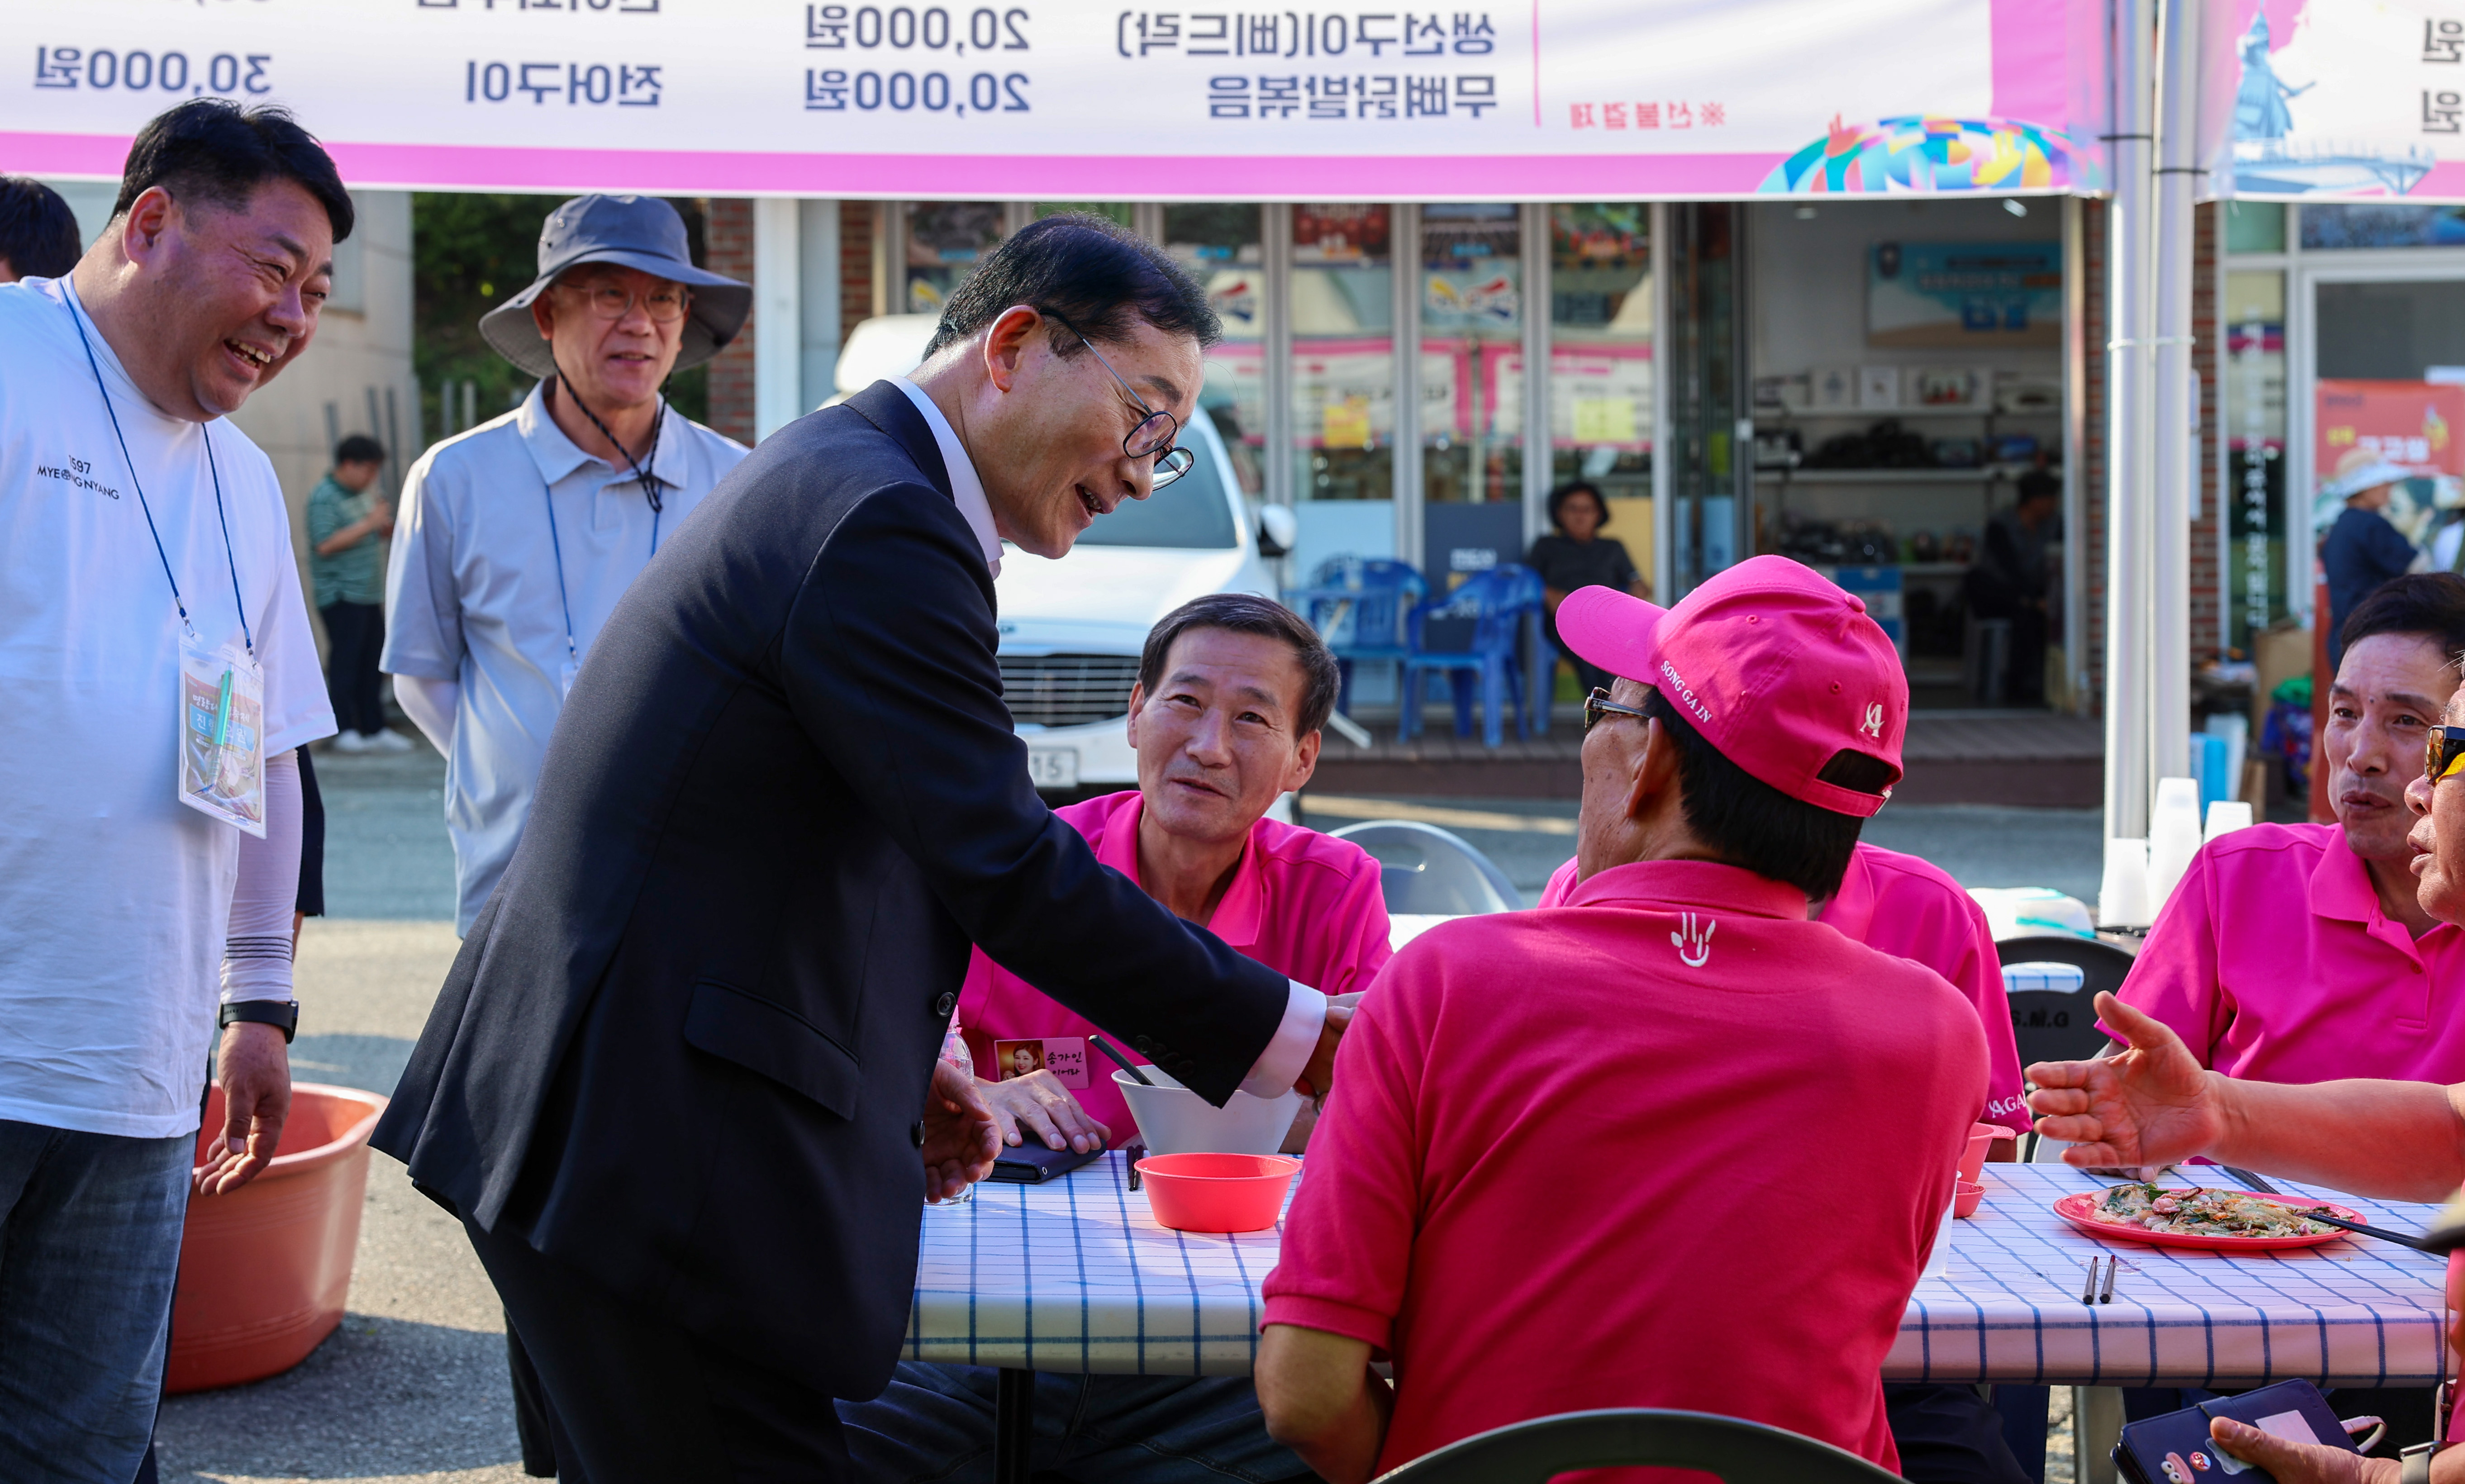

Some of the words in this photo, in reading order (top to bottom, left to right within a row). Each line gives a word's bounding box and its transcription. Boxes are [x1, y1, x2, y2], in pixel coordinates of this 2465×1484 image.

[69, 455, 91, 474] 1597
[1661, 660, 1685, 691] SONG
[1682, 690, 1698, 709] GA
[1695, 705, 1713, 723] IN
[1047, 1051, 1082, 1065] 송가인
